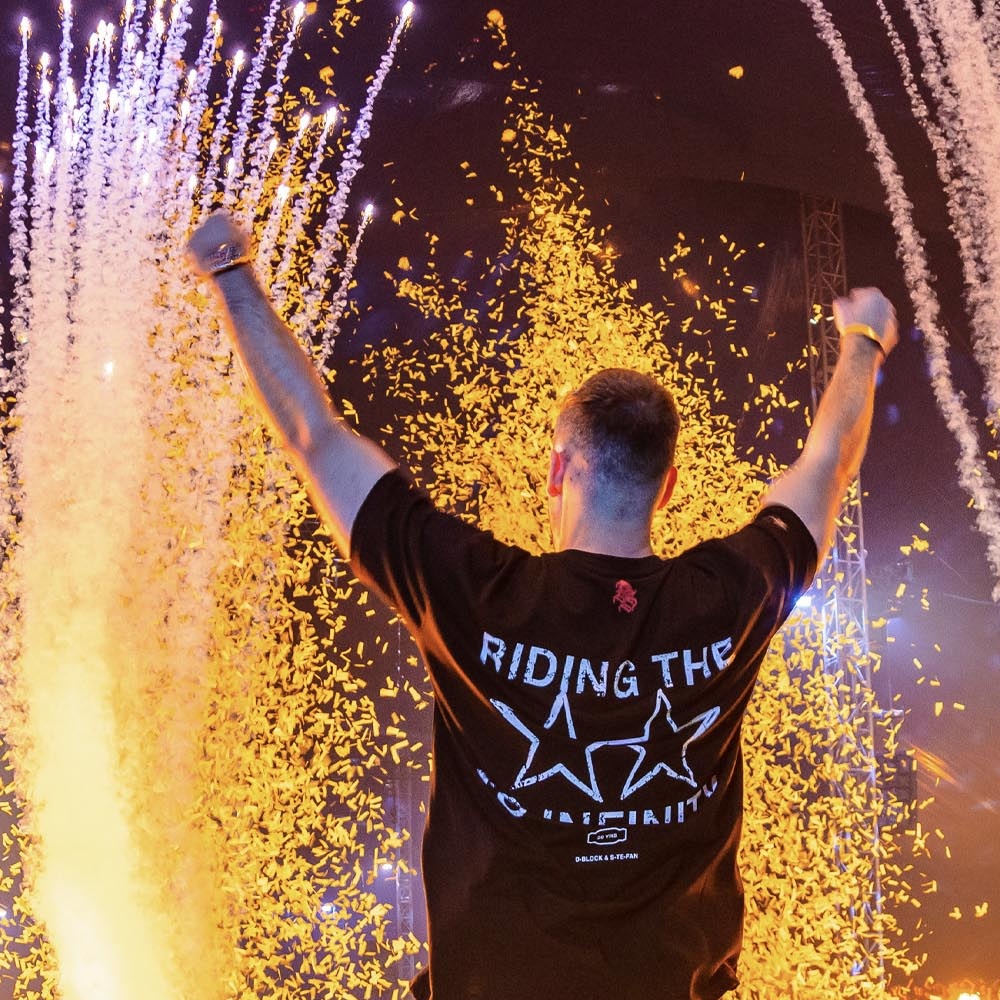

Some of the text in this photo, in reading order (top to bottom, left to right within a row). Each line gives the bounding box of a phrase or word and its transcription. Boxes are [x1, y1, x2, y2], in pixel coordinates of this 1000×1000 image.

[479, 631, 738, 699] RIDING THE
[575, 854, 603, 863] D-BLOCK
